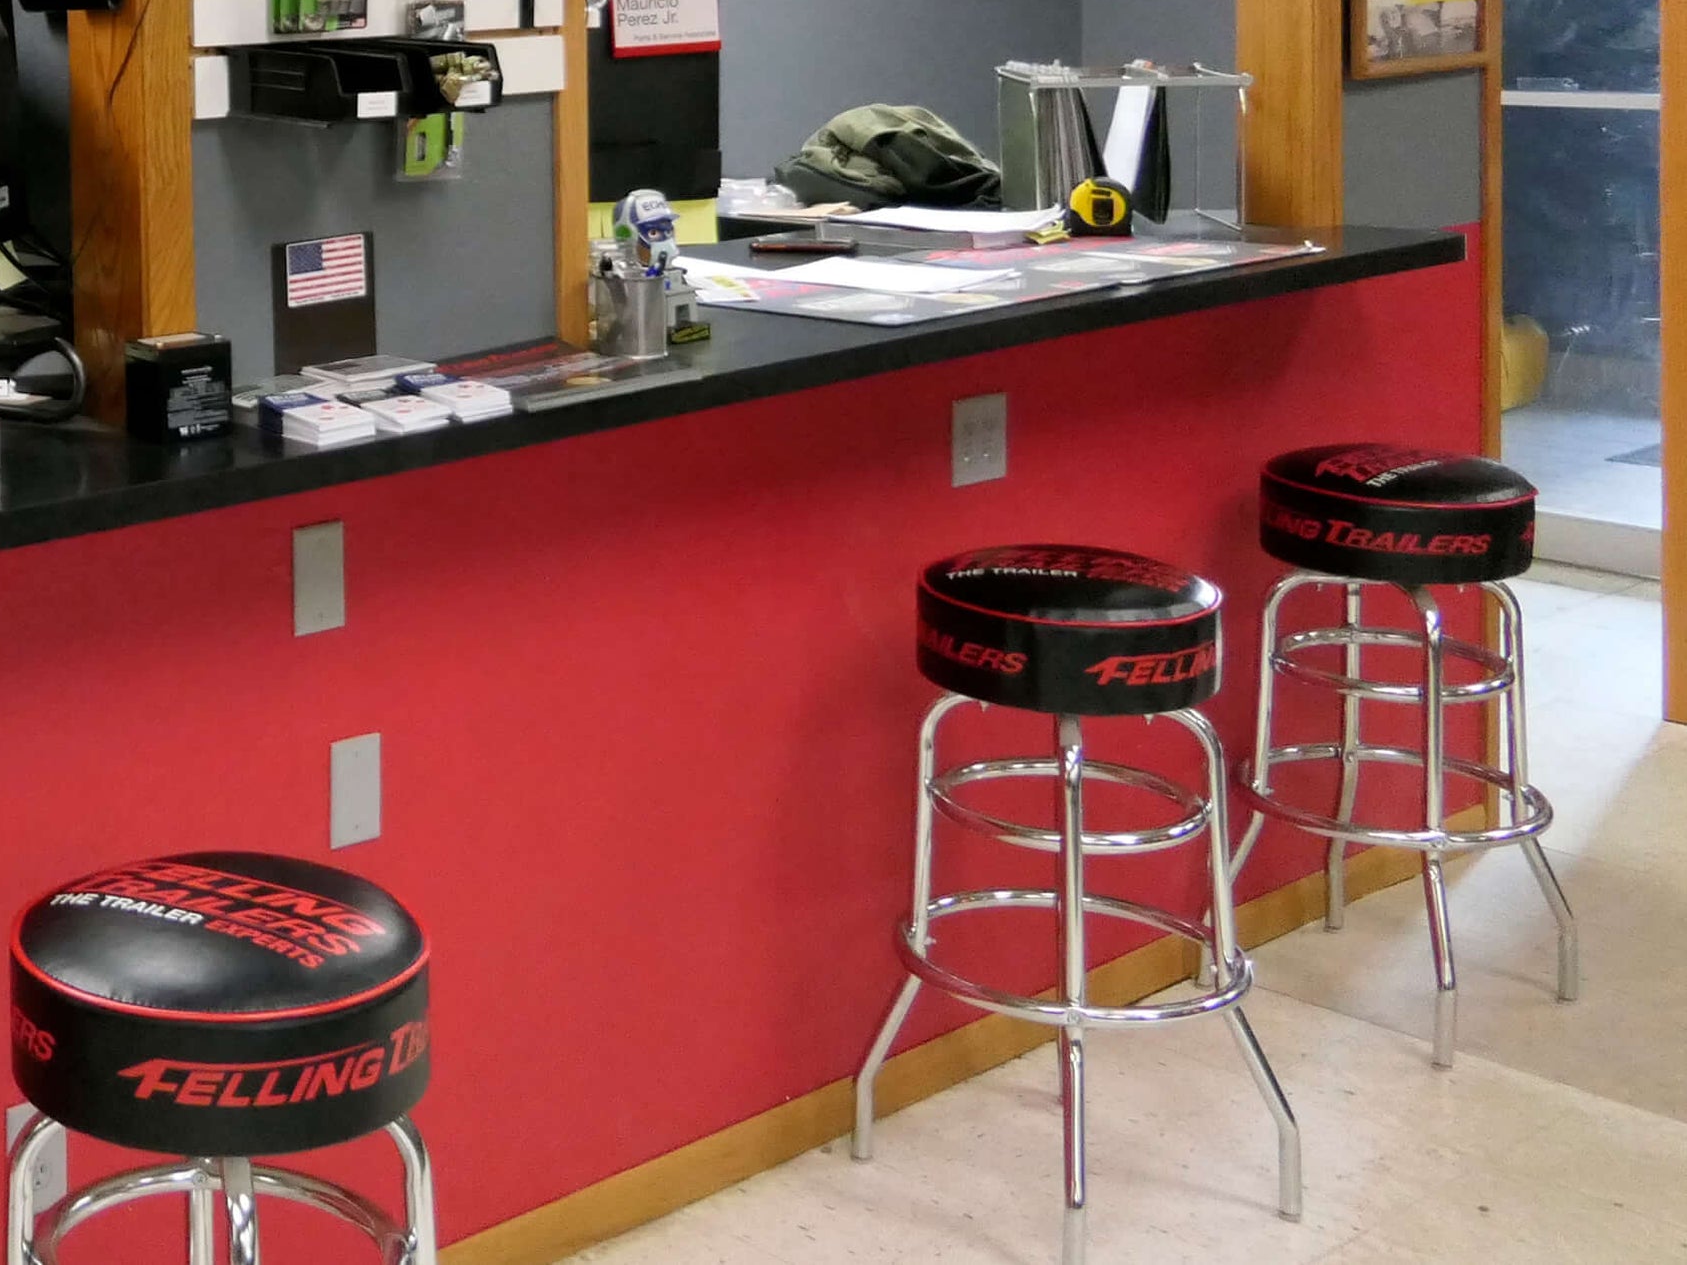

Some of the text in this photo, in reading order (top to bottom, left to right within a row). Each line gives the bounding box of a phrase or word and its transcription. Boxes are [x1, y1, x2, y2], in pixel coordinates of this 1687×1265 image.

[616, 10, 679, 28] Perez Jr.
[1324, 519, 1492, 557] TRAILERS
[992, 566, 1078, 578] TRAILER
[50, 892, 328, 970] THE TRAILER EXPERTS
[117, 1038, 388, 1109] FELLING
